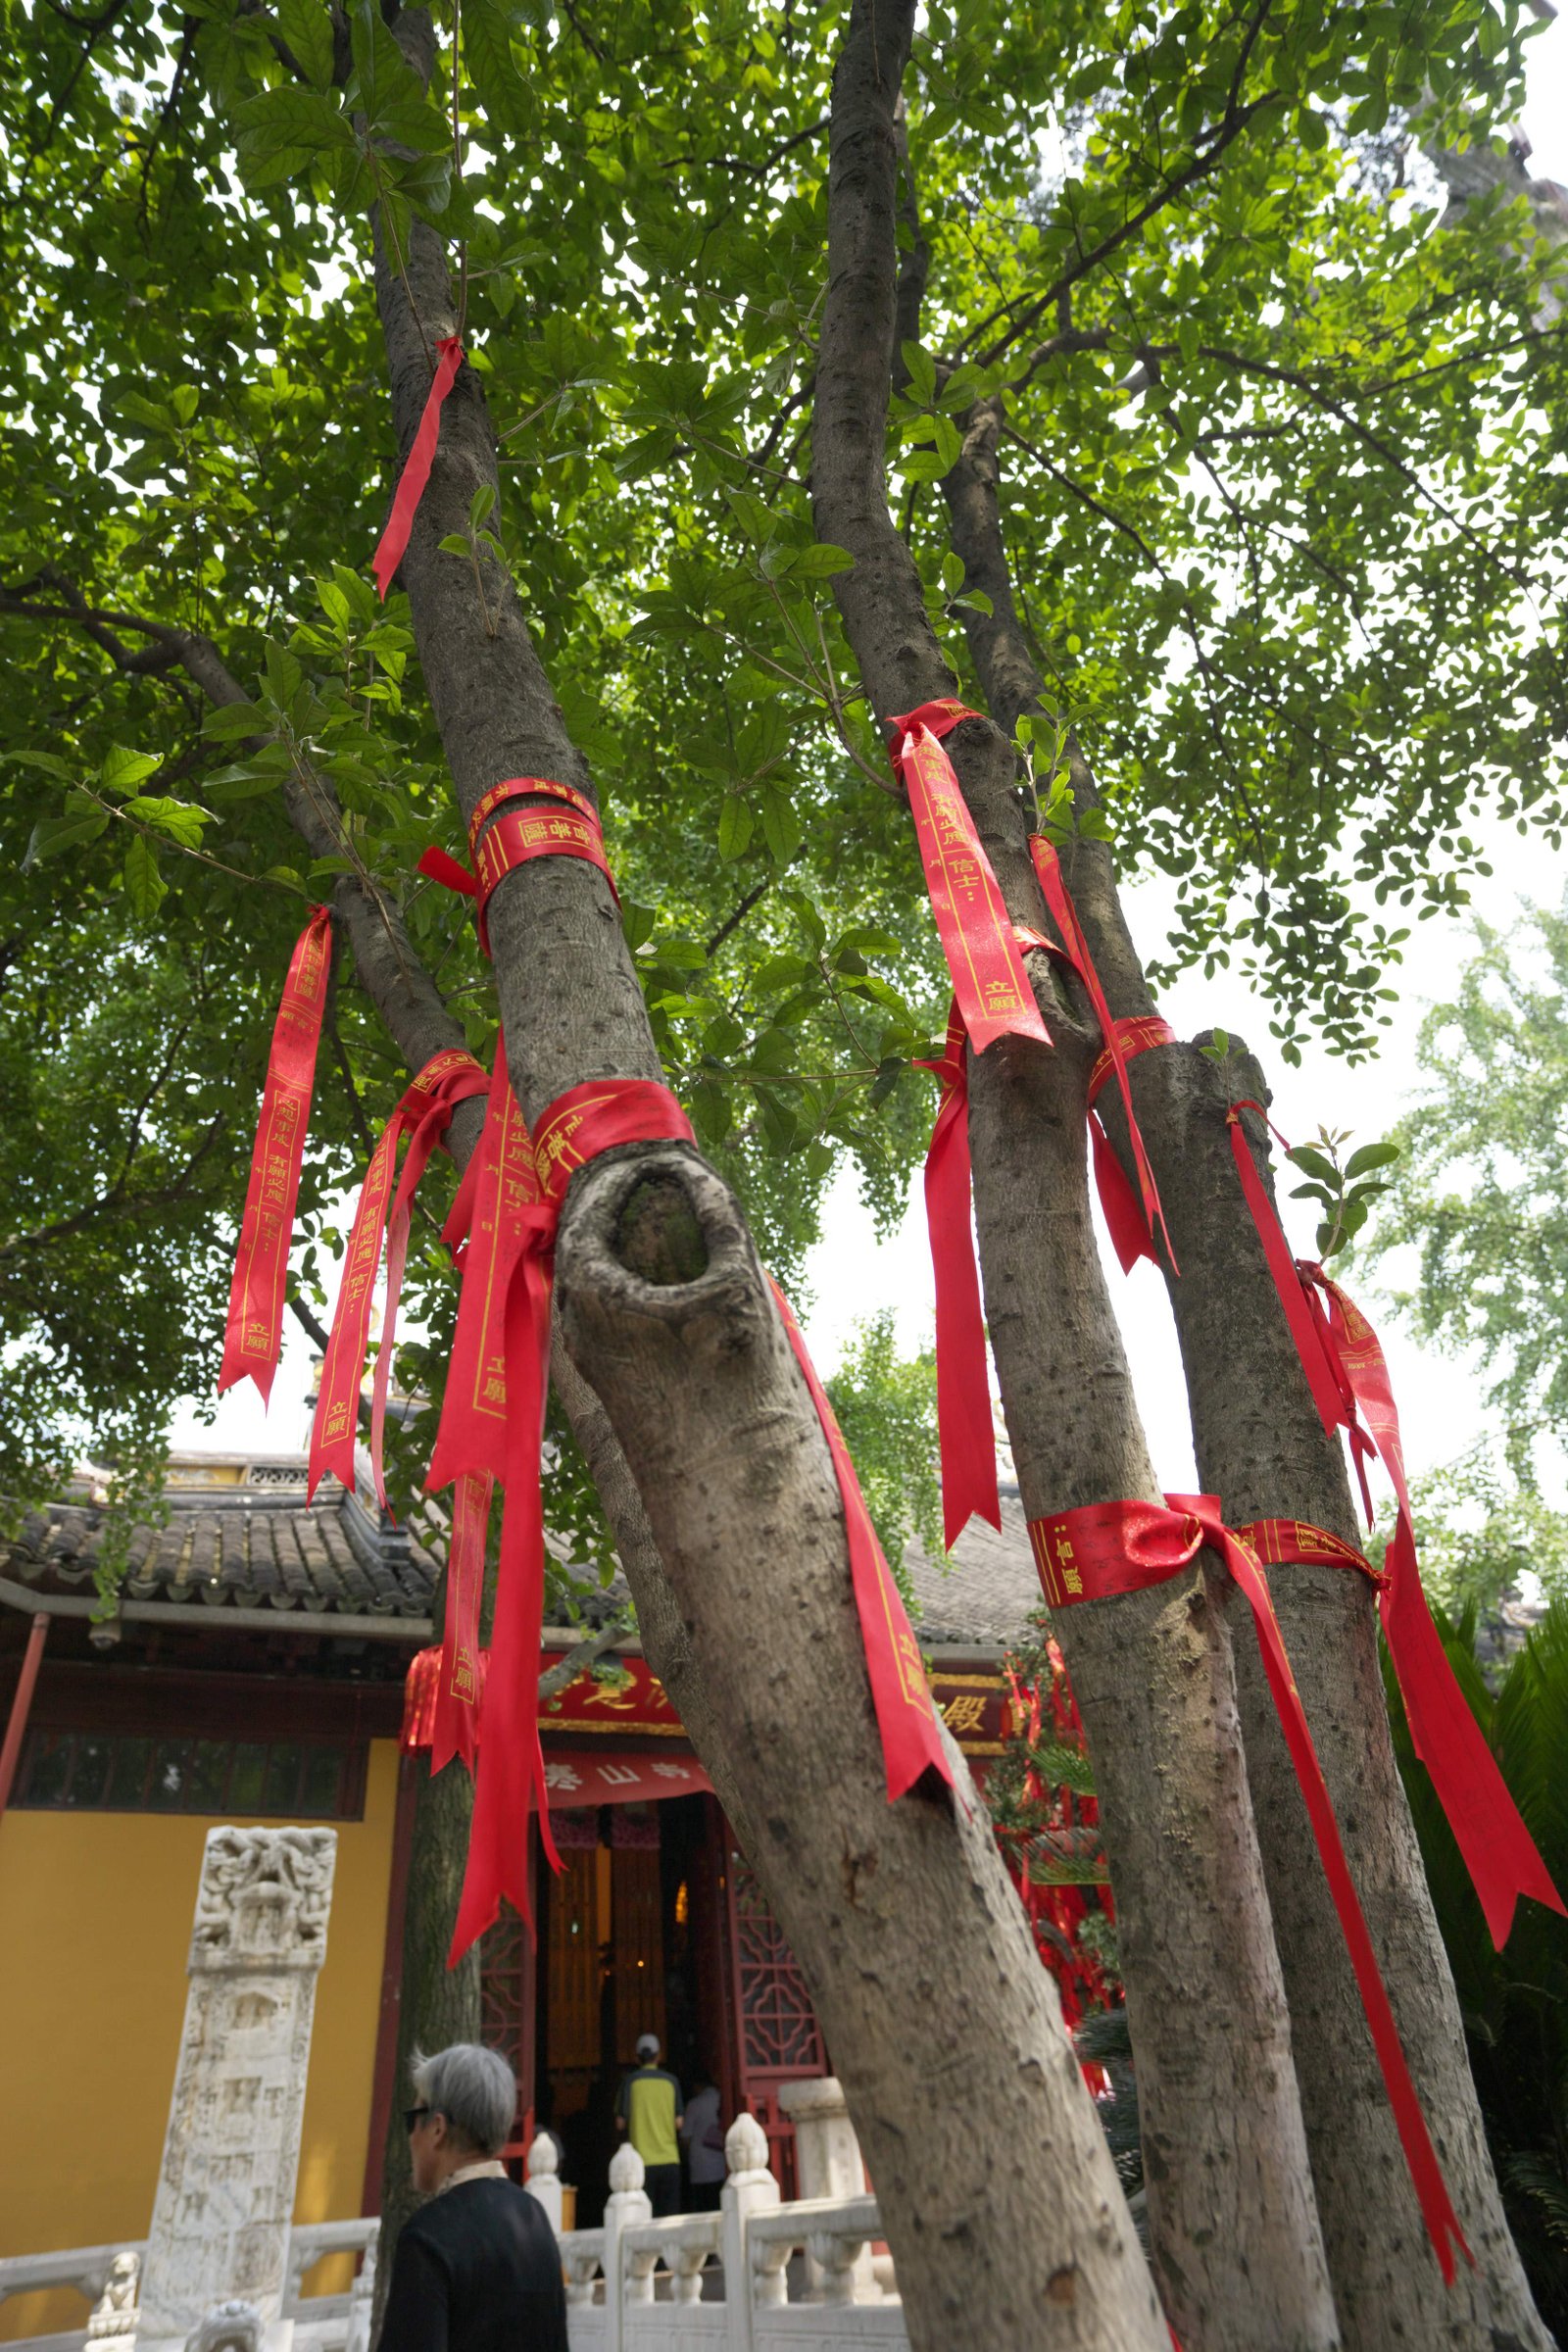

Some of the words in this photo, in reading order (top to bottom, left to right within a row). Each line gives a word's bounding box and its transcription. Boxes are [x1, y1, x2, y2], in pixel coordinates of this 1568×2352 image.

[985, 981, 1017, 1011] 立願
[246, 1322, 270, 1351] 立願
[326, 1401, 348, 1437] 立願
[941, 1695, 988, 1732] 殿
